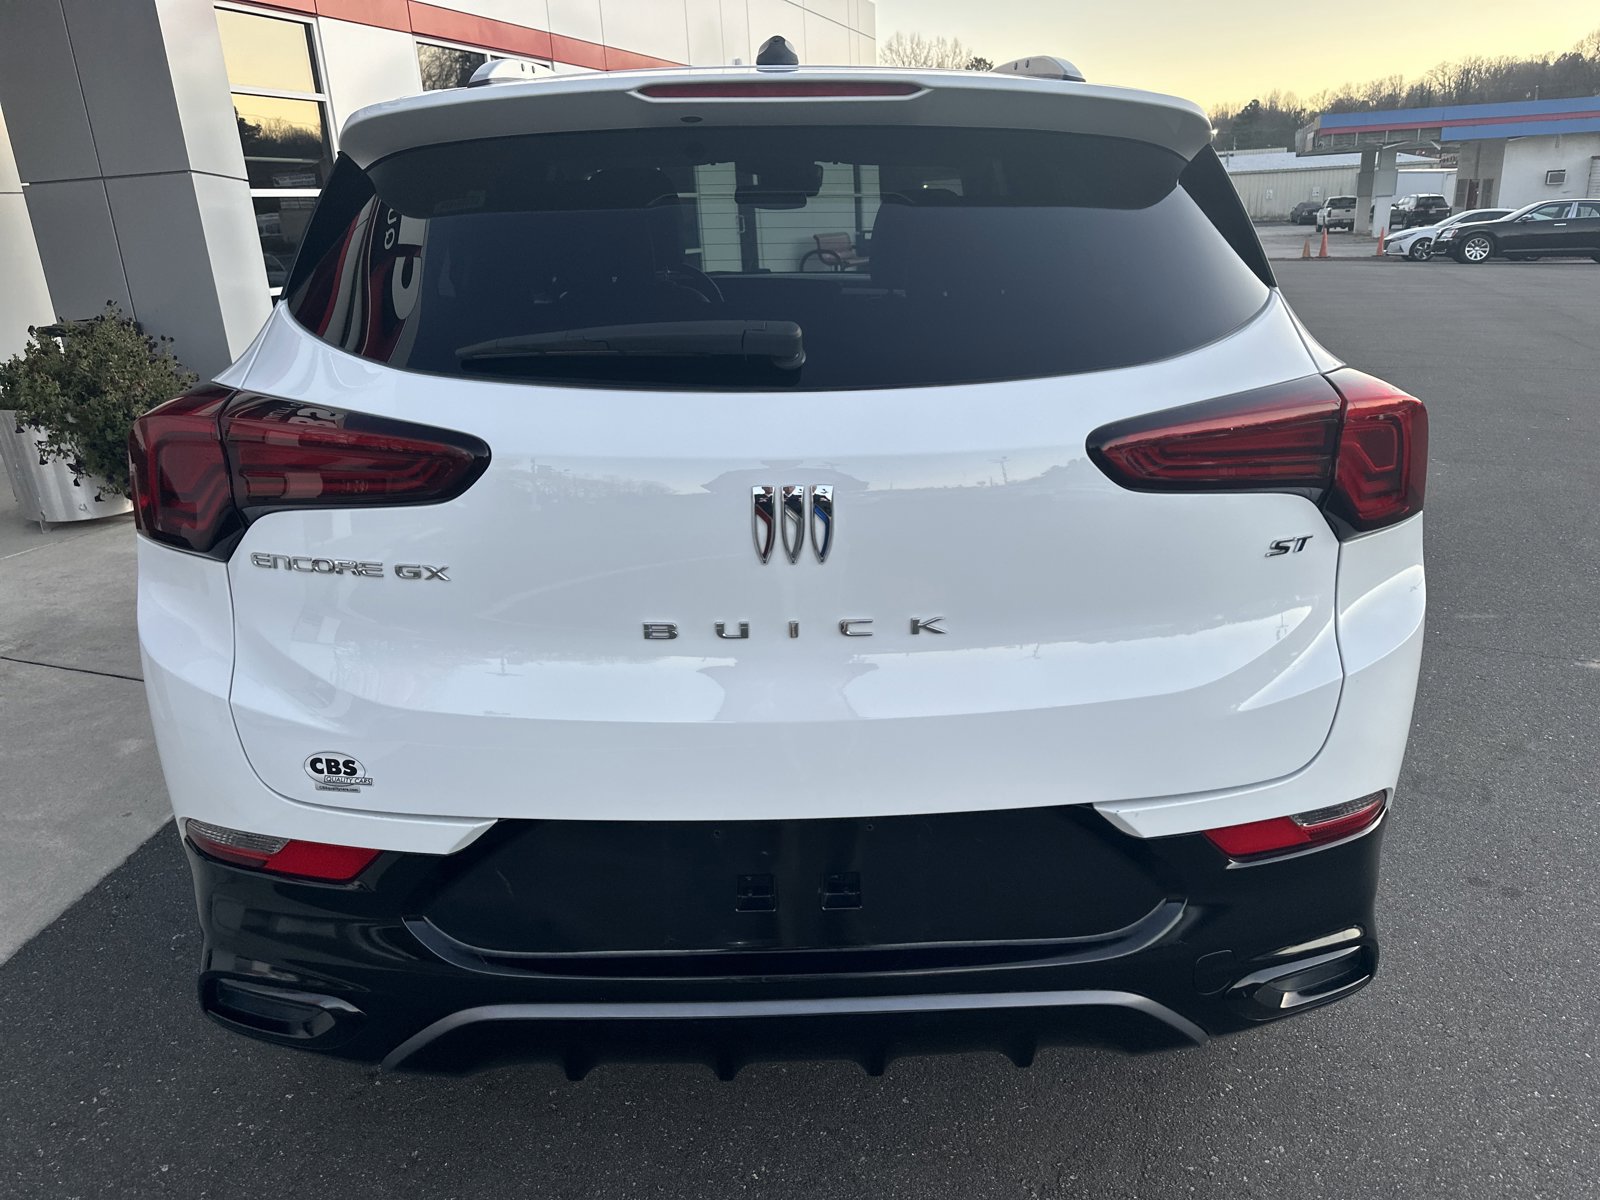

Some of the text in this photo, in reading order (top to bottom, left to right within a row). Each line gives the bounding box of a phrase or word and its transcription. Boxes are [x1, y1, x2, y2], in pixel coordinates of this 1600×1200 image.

[1265, 535, 1313, 557] ST
[251, 552, 450, 582] ENCORE GX
[643, 616, 947, 640] BUICK
[309, 757, 358, 776] CBS
[325, 776, 353, 784] QUALITY
